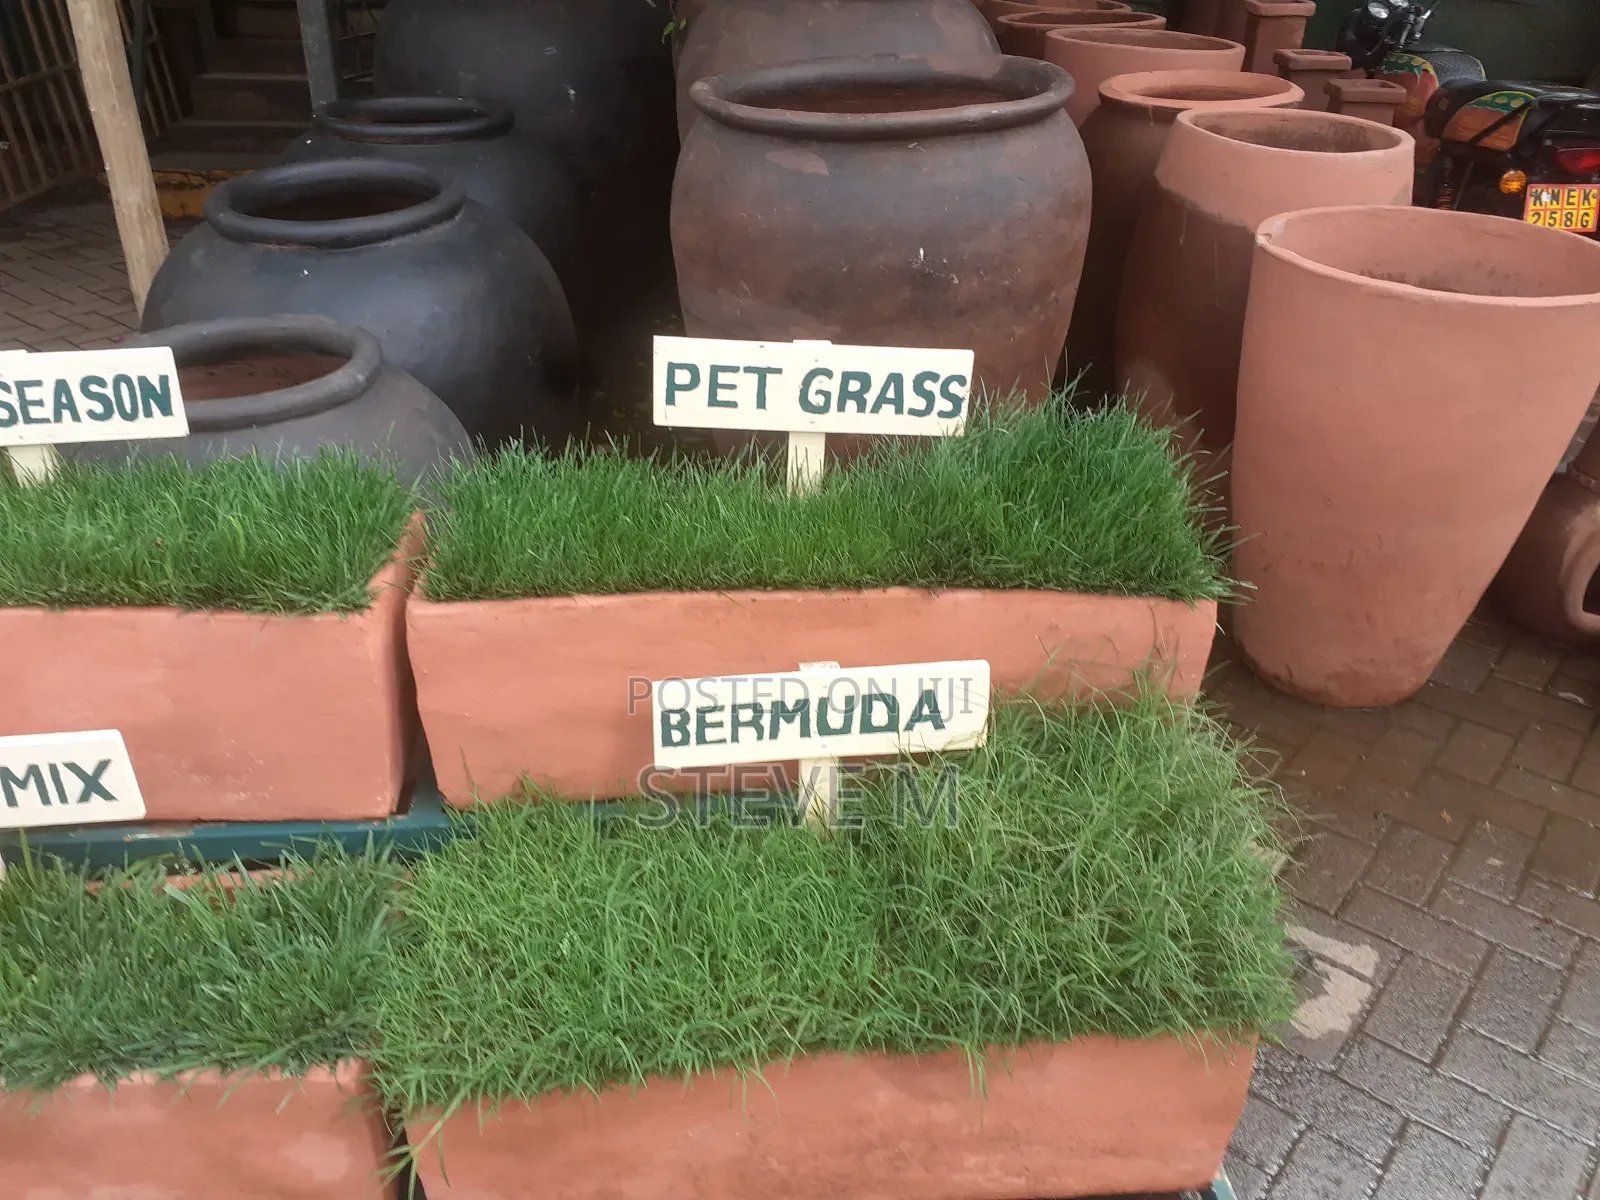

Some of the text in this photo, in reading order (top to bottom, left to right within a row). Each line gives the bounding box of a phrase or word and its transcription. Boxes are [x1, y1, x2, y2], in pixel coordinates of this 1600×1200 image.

[1531, 211, 1590, 228] 258G
[665, 362, 967, 419] PET GRASS
[660, 688, 946, 748] BERMUDA
[0, 759, 119, 808] MIX
